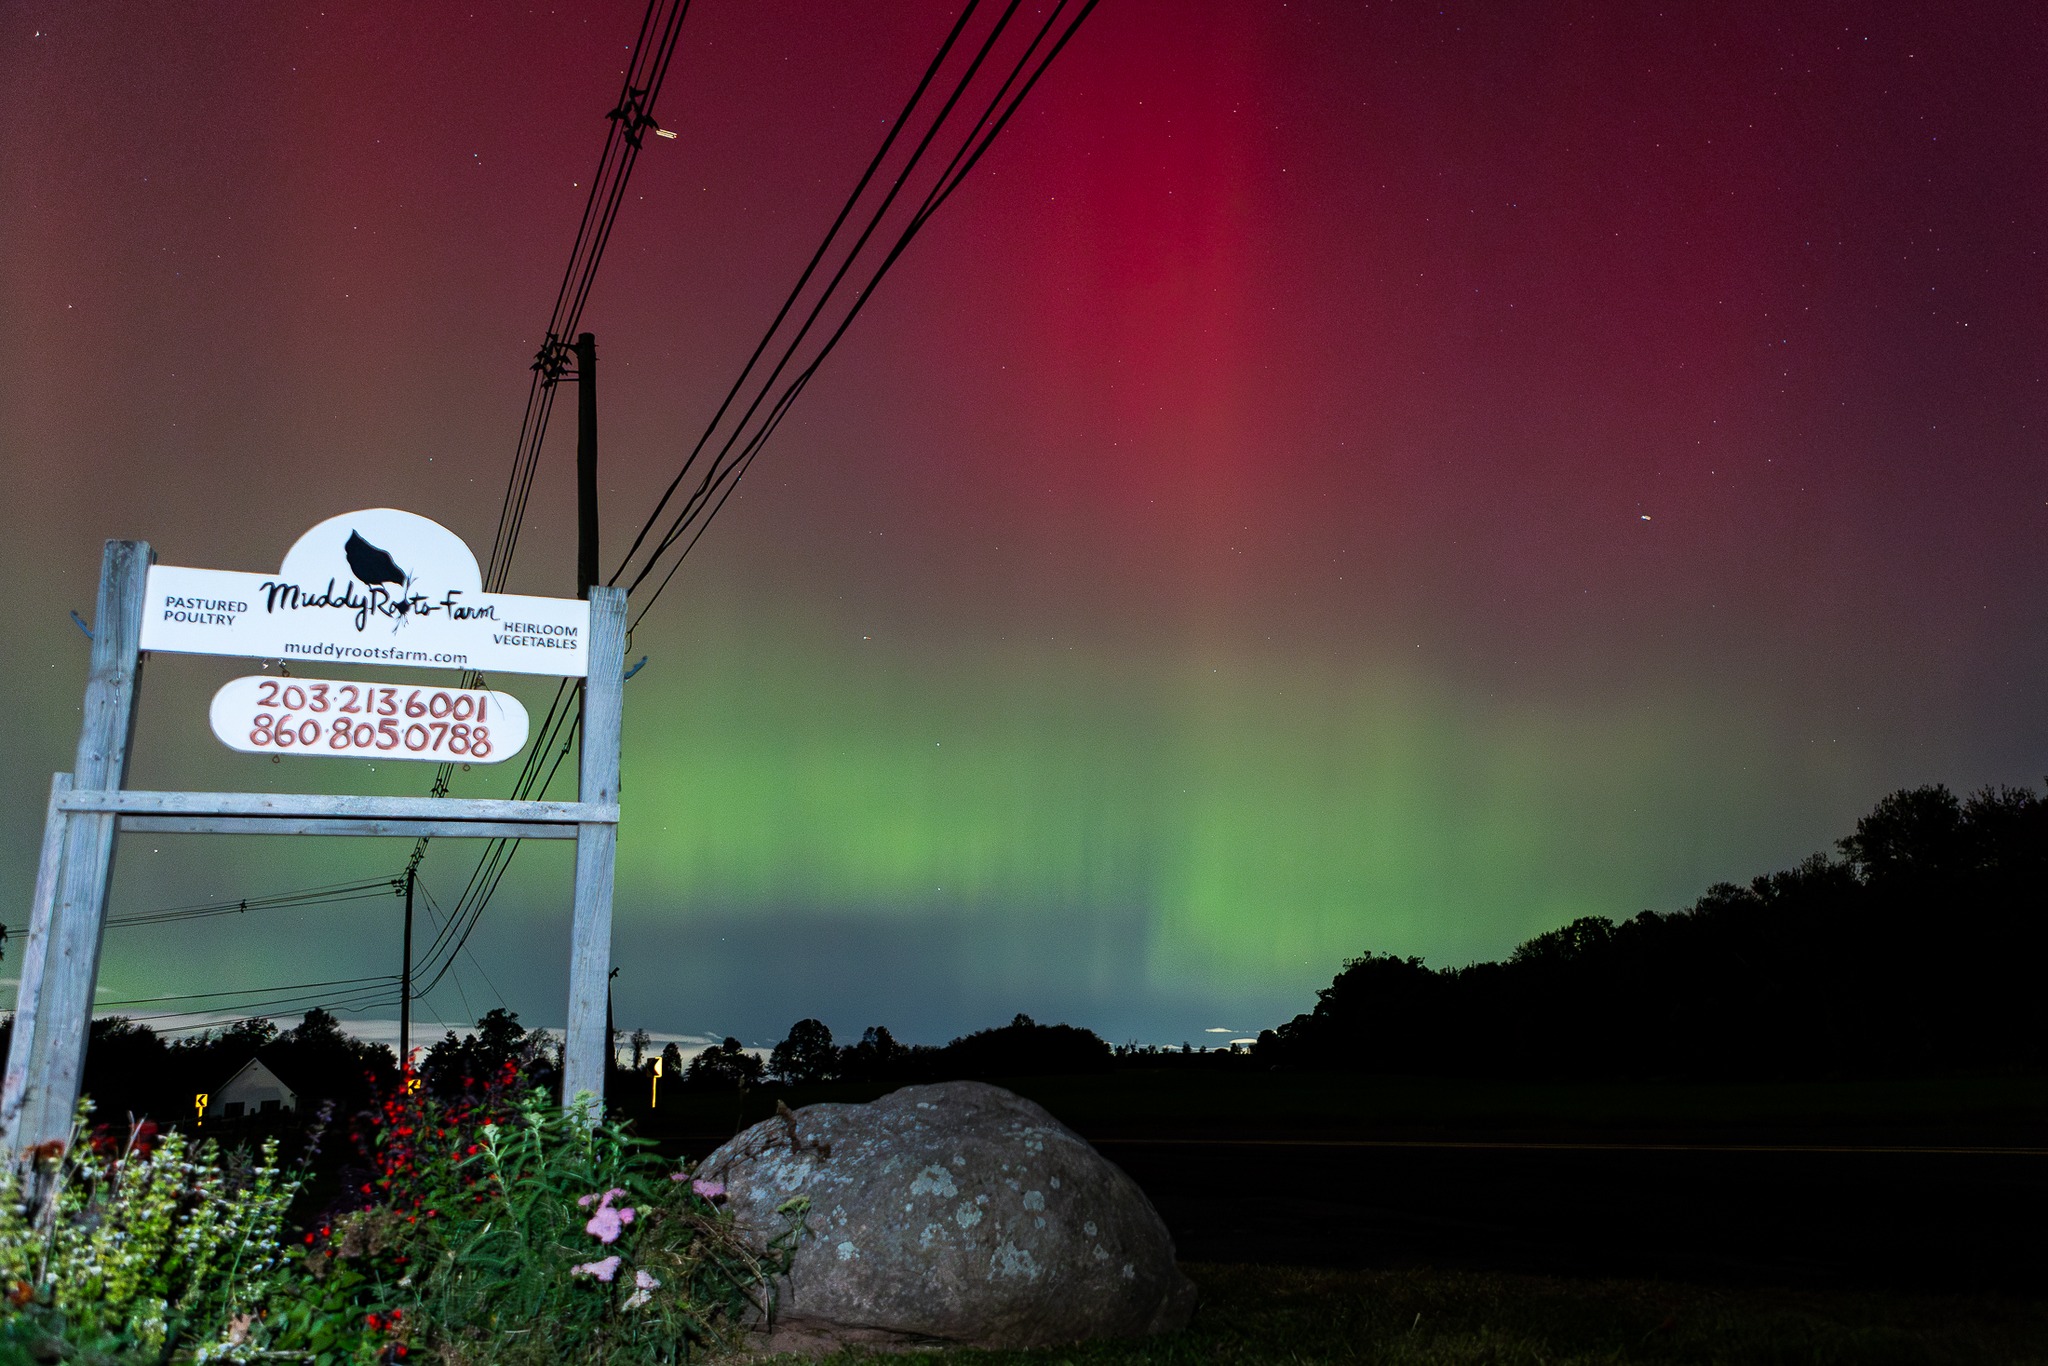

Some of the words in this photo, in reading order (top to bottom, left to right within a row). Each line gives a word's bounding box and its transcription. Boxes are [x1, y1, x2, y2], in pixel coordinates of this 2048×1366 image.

[166, 596, 248, 613] PASTURED
[259, 577, 368, 632] Muddy
[367, 587, 441, 619] Roots
[440, 590, 500, 621] Farm
[164, 610, 236, 626] POULTRY
[504, 621, 578, 637] HEIRLOOM
[493, 634, 578, 650] VEGETABLES
[285, 642, 468, 664] muddyrootsfarm.com
